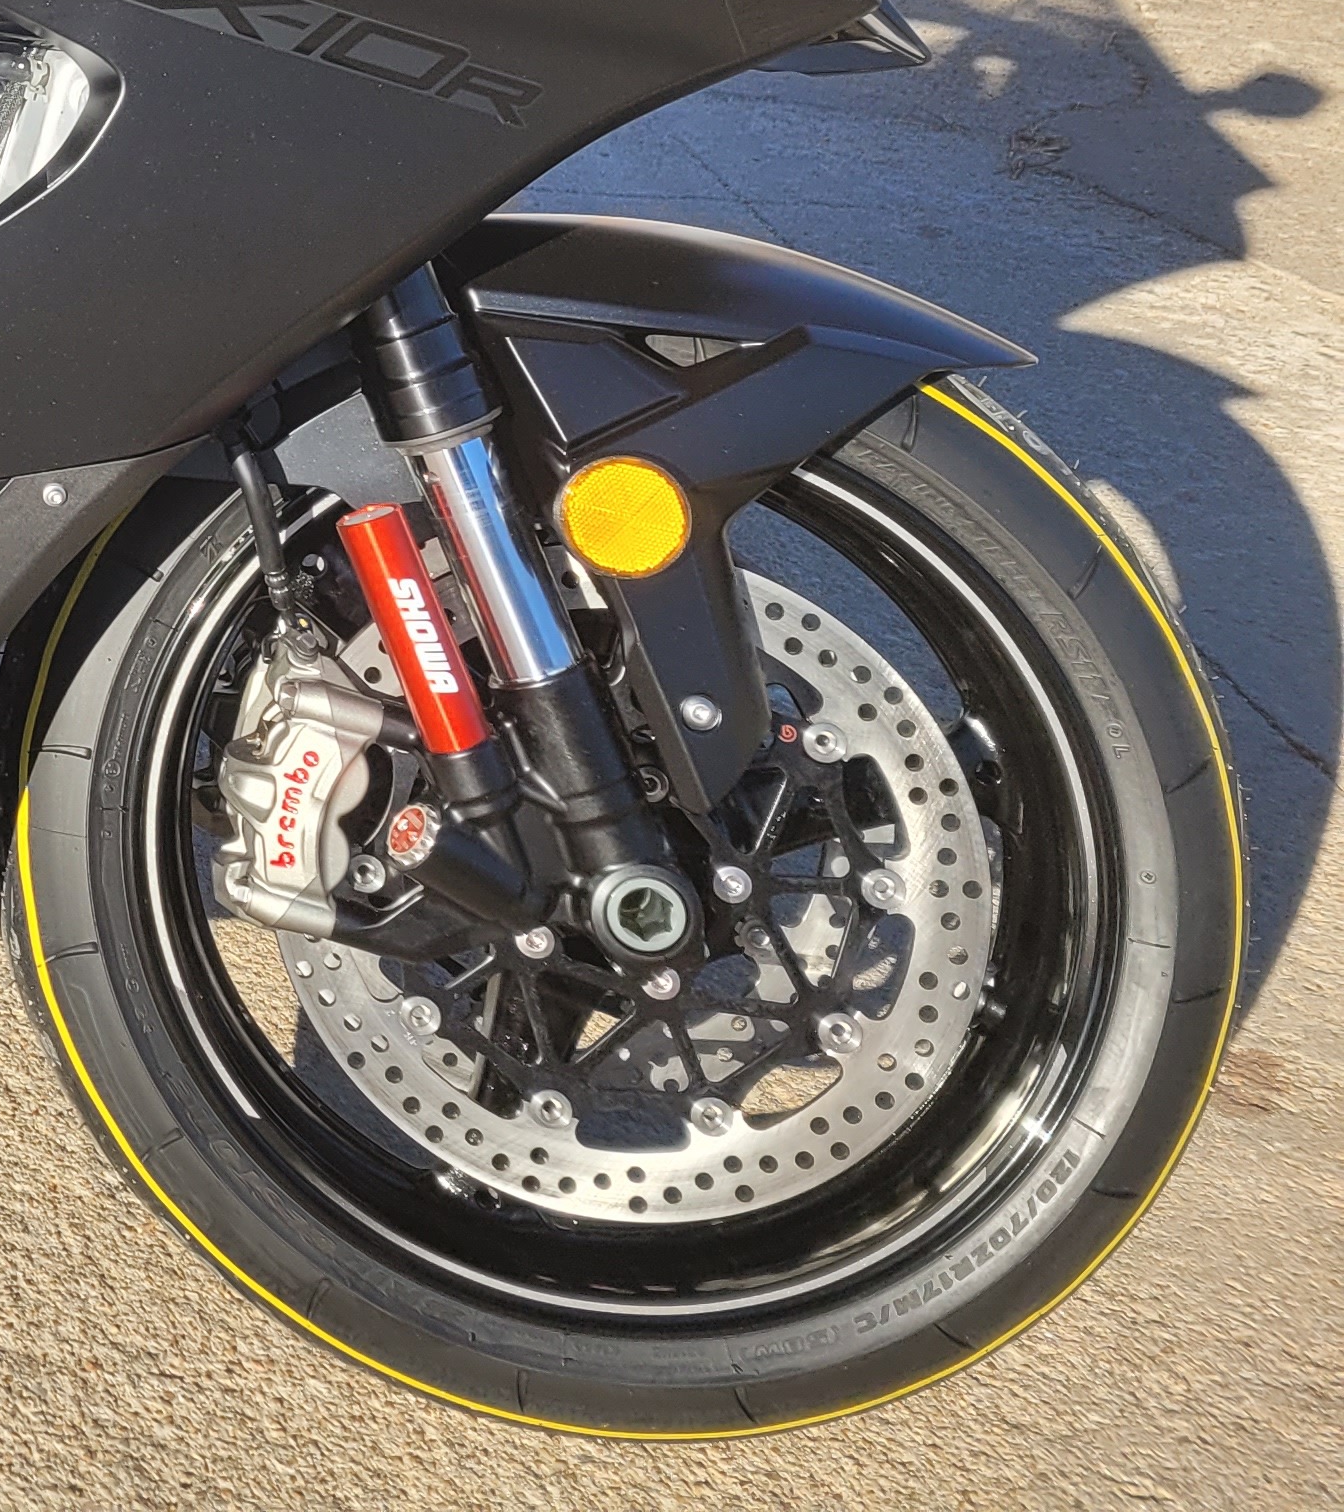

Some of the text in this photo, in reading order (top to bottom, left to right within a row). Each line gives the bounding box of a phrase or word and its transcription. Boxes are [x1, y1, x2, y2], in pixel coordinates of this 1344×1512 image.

[388, 577, 459, 695] SHOWA
[270, 750, 320, 870] brembo
[853, 1147, 1082, 1335] 120/70ZR17M/C
